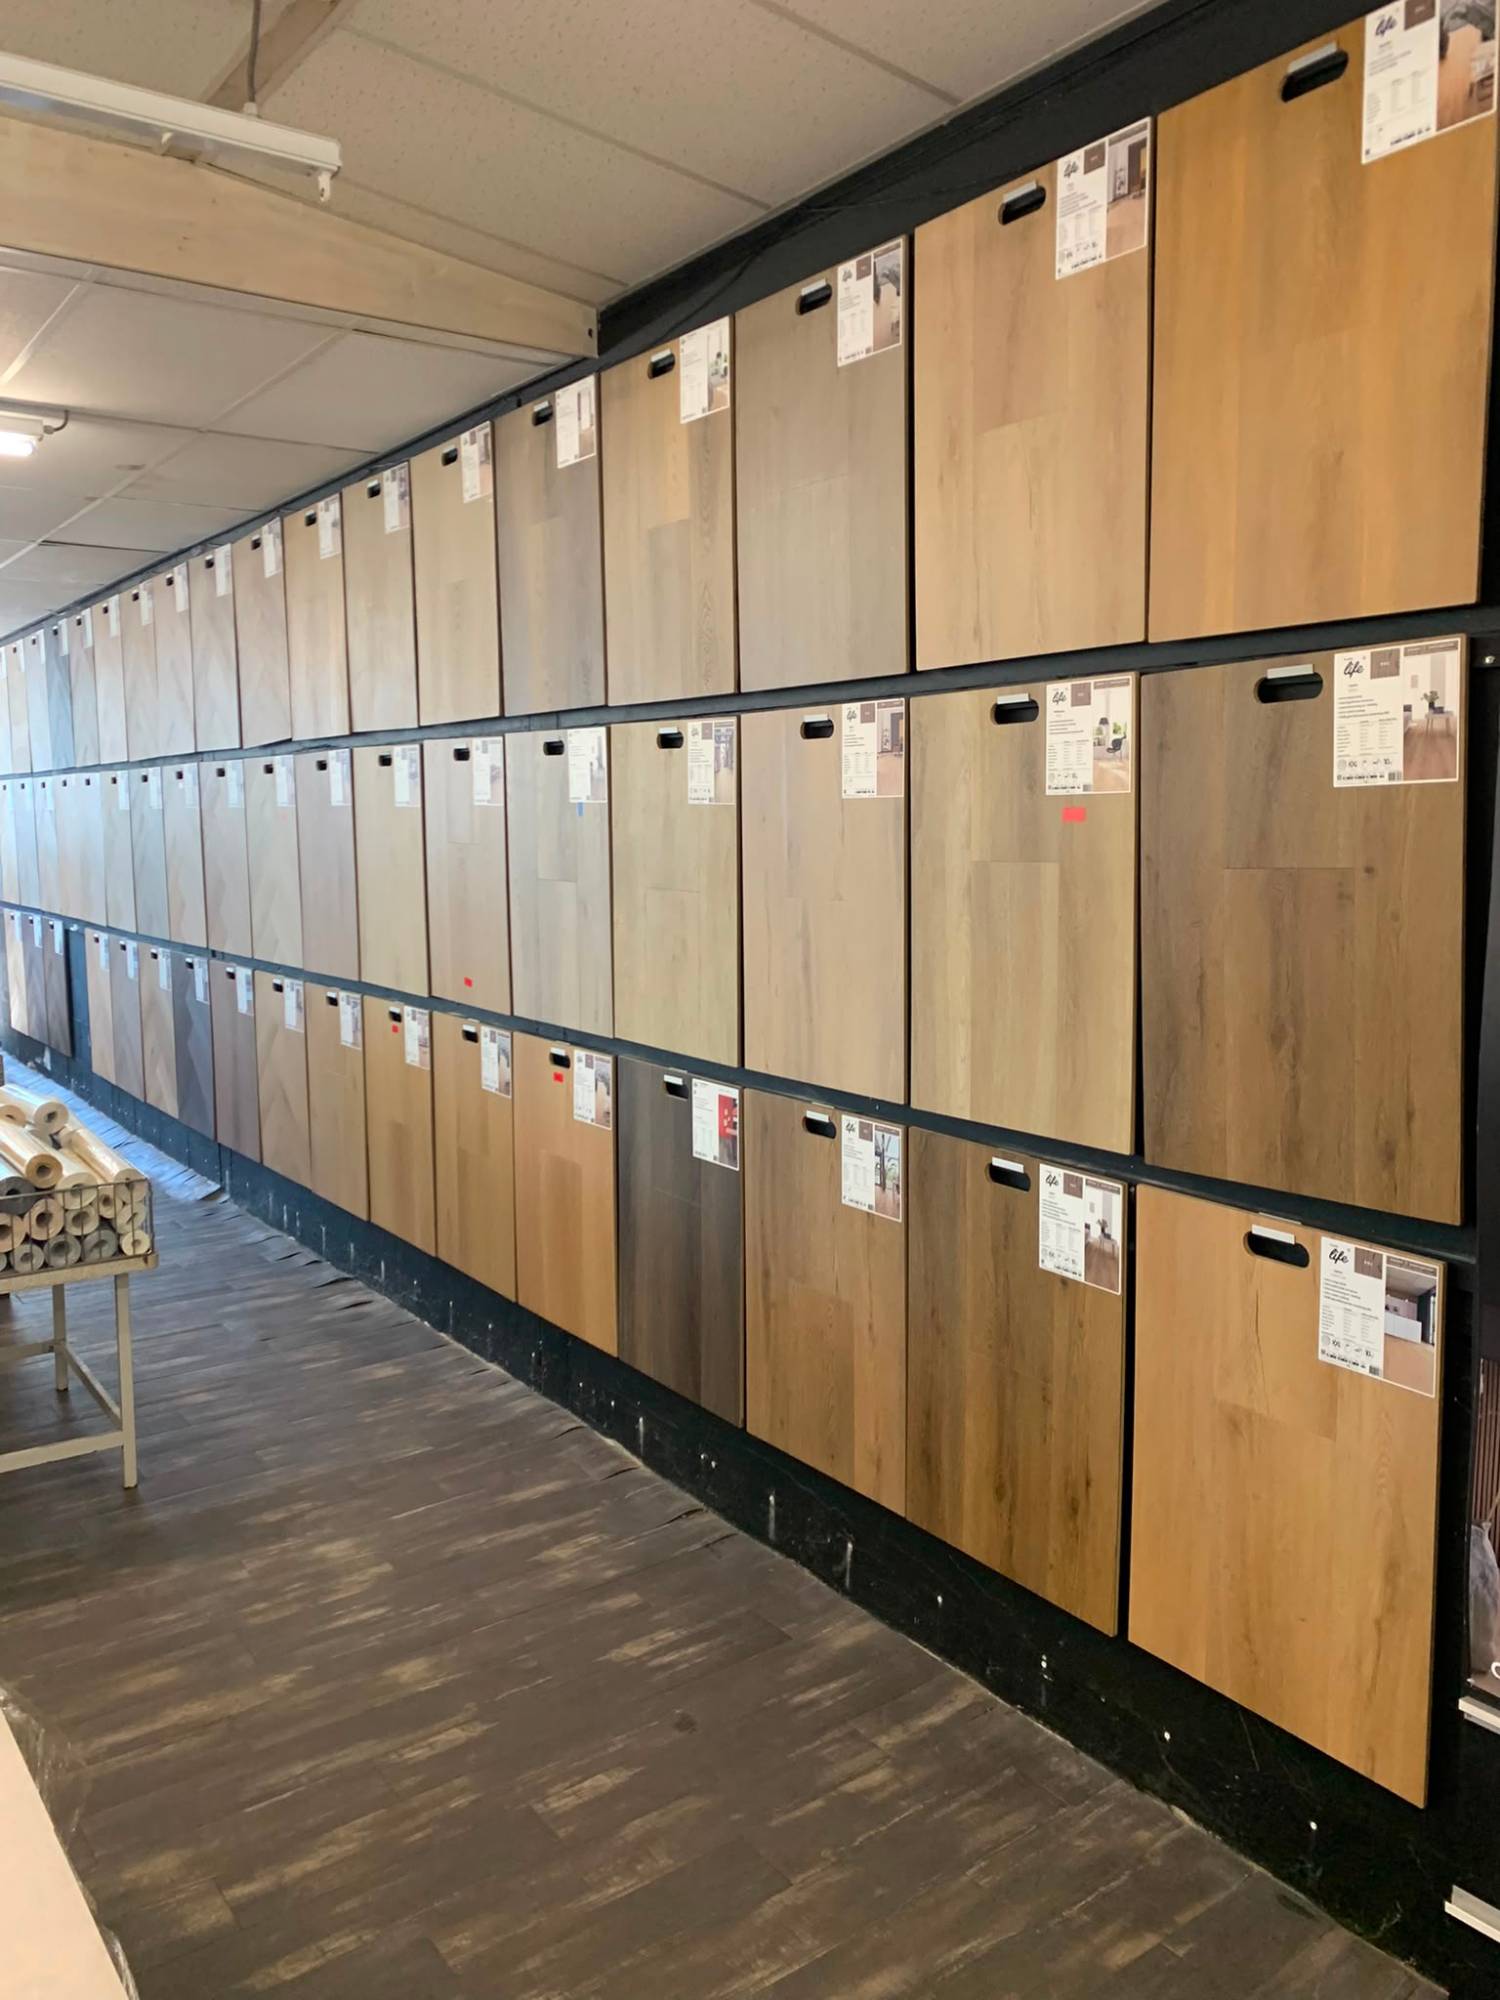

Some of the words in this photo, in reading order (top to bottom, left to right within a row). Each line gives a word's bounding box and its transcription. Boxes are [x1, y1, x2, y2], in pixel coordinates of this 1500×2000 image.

[1344, 661, 1364, 679] life
[1052, 691, 1067, 705] life
[1046, 1174, 1059, 1187] life
[1329, 1248, 1349, 1264] life
